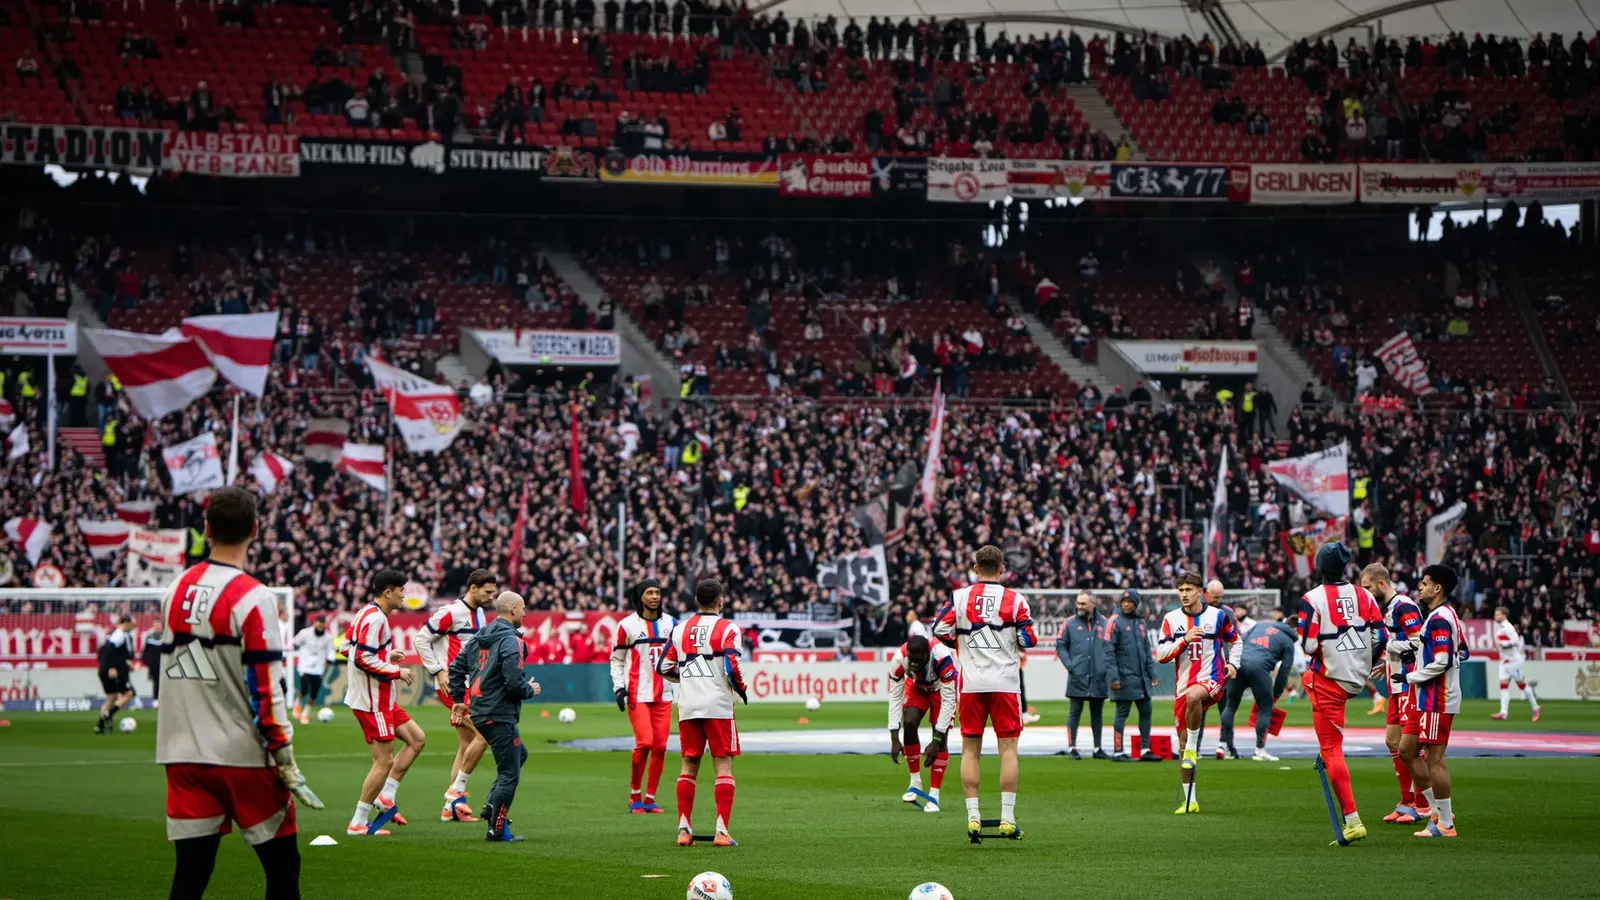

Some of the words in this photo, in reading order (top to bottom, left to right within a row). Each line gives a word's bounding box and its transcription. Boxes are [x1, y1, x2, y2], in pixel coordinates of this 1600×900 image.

[0, 126, 165, 167] TADION
[175, 131, 298, 152] ALBSTADT
[177, 153, 295, 175] VFB-FANS
[300, 142, 406, 165] NECKAR-FILS
[450, 149, 541, 170] STUTTGART
[631, 154, 666, 177] Old
[670, 155, 751, 178] Warriors
[1194, 168, 1226, 195] 77
[1255, 171, 1353, 192] GERLINGEN
[753, 671, 880, 701] Stuttgarter
